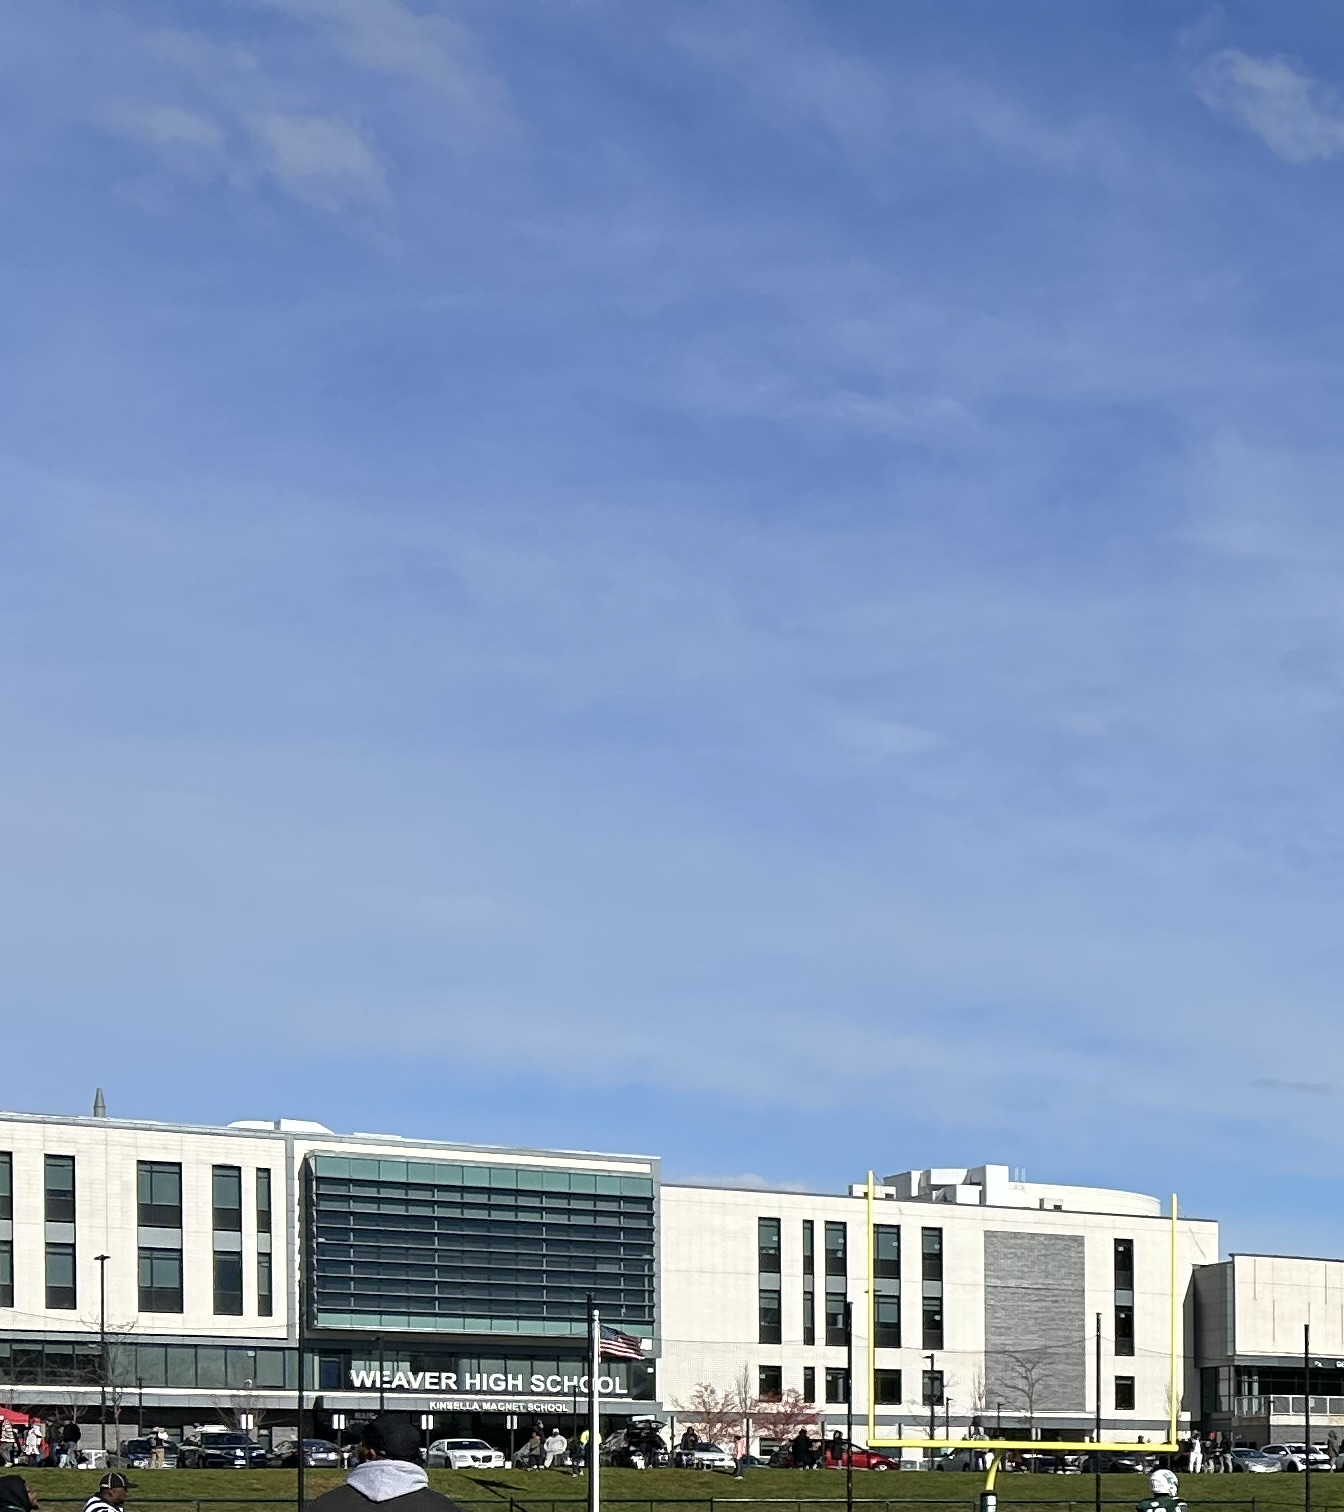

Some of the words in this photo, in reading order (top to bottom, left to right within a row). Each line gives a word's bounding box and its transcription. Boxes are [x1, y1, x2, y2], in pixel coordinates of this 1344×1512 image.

[350, 1370, 457, 1390] WEAVER
[465, 1373, 523, 1392] HIGH
[530, 1374, 628, 1395] SCHOOL
[429, 1401, 480, 1411] KINSELLA
[482, 1402, 527, 1412] MAGNET
[527, 1402, 568, 1413] SCHOOL
